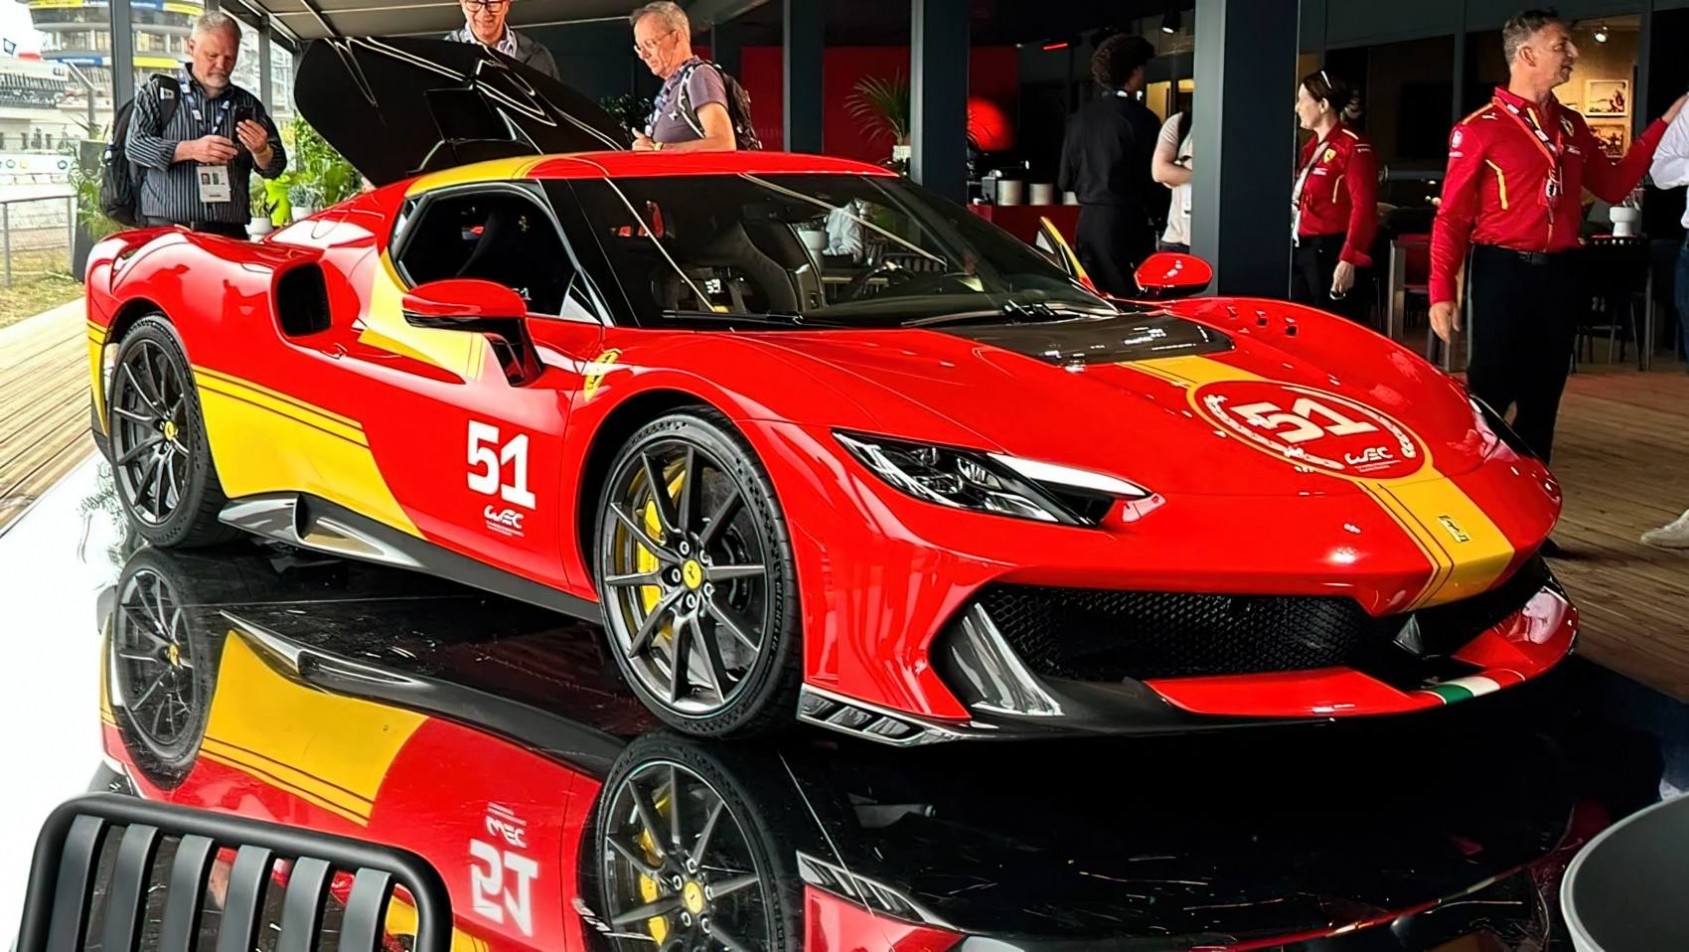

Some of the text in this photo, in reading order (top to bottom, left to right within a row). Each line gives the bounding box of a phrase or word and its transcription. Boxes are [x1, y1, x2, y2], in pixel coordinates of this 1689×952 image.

[1229, 398, 1379, 443] 51
[467, 419, 536, 510] 51
[1344, 446, 1394, 464] WEC
[484, 505, 524, 529] WEC
